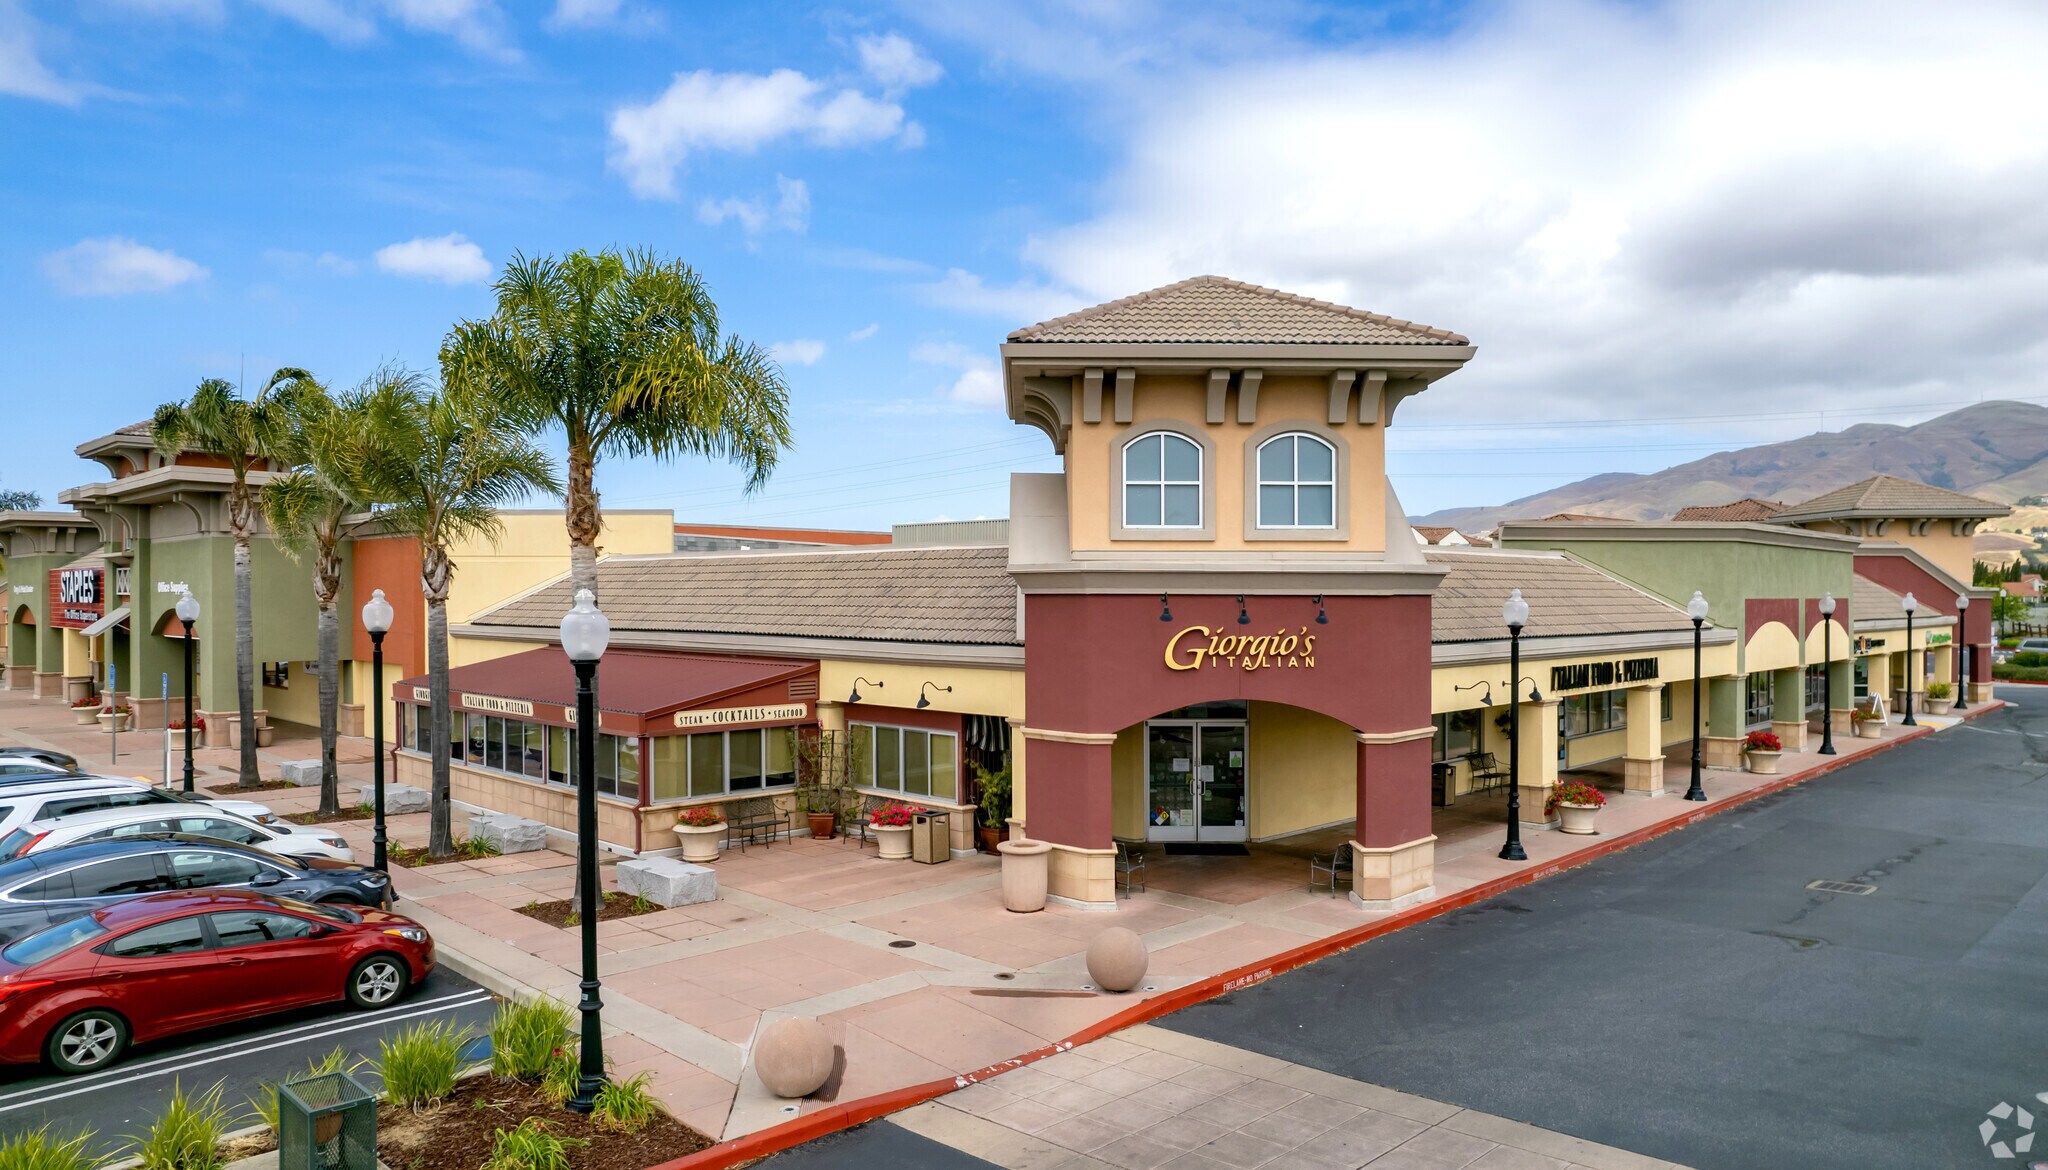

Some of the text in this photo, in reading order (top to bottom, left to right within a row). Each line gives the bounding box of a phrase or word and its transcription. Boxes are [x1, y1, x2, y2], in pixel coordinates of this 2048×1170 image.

[60, 570, 94, 603] STAPLES
[158, 581, 170, 592] Office
[1164, 625, 1316, 671] Giorgio's
[1212, 656, 1315, 668] ITALIAN
[1550, 663, 1590, 691] ITALIAN
[1590, 661, 1614, 687] FOOD
[1614, 660, 1622, 683] &
[415, 689, 430, 699] GIORGI
[464, 695, 485, 708] ITALIAN
[486, 698, 499, 710] FOOD
[505, 701, 530, 714] PIZZERIA
[680, 708, 803, 725] STEAK COCKTAILS SEAFOOD
